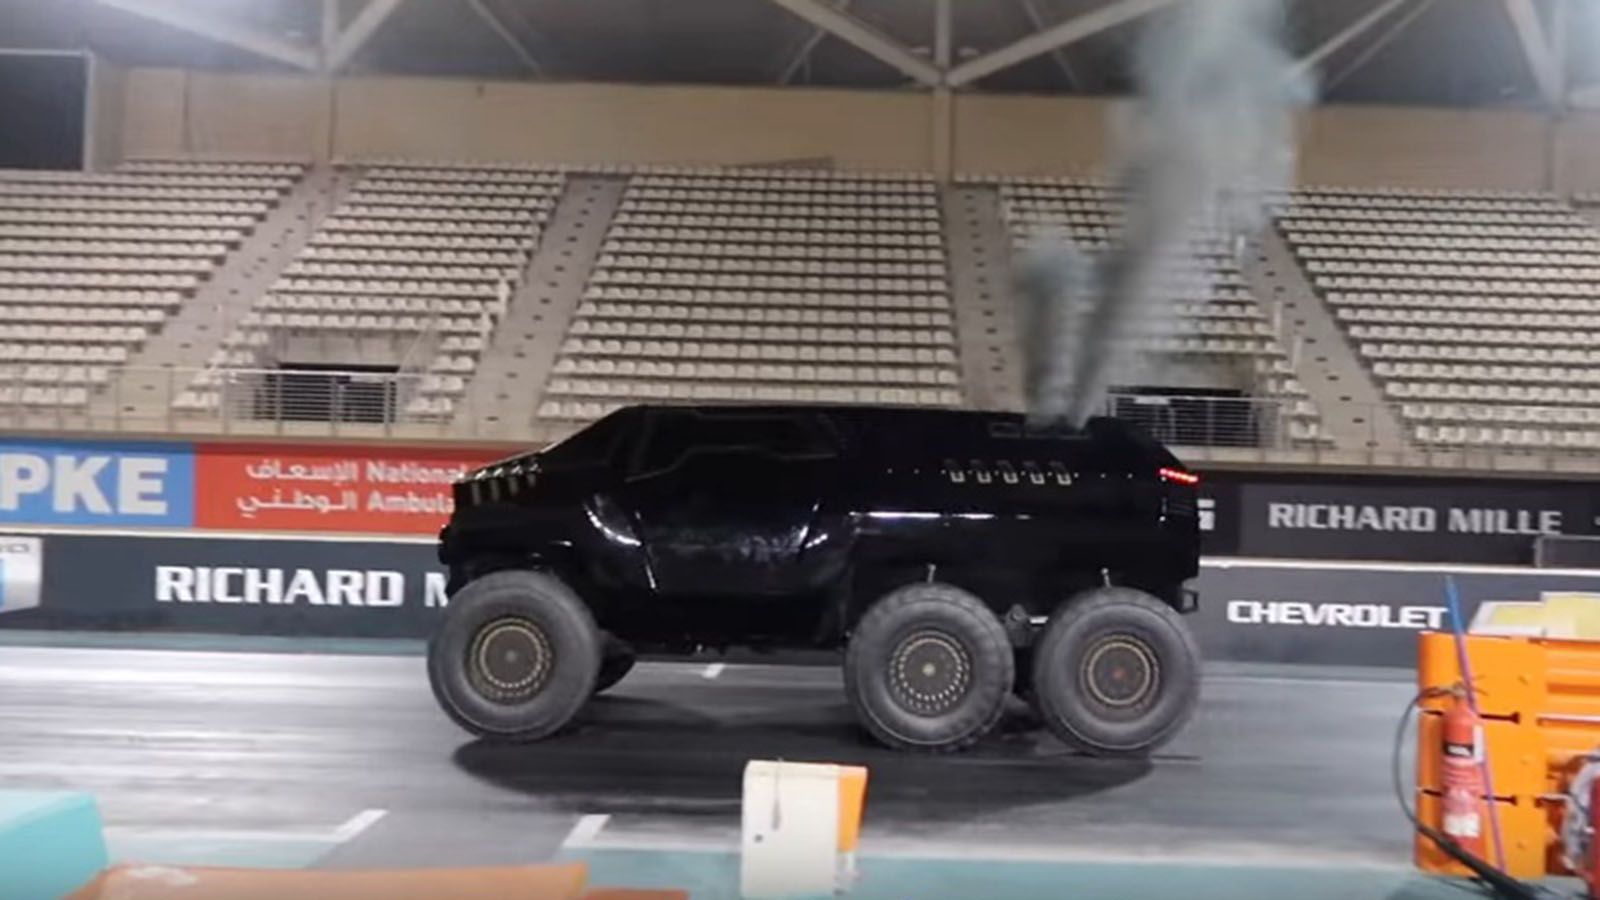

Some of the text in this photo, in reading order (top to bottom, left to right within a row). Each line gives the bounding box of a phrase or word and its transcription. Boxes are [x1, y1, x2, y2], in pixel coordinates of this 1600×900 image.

[366, 460, 467, 484] National
[367, 490, 455, 514] Ambula
[1268, 502, 1436, 532] RICHARD
[1447, 508, 1562, 535] MILLE
[155, 565, 405, 607] RICHARD
[1227, 600, 1449, 628] CHEVROLET
